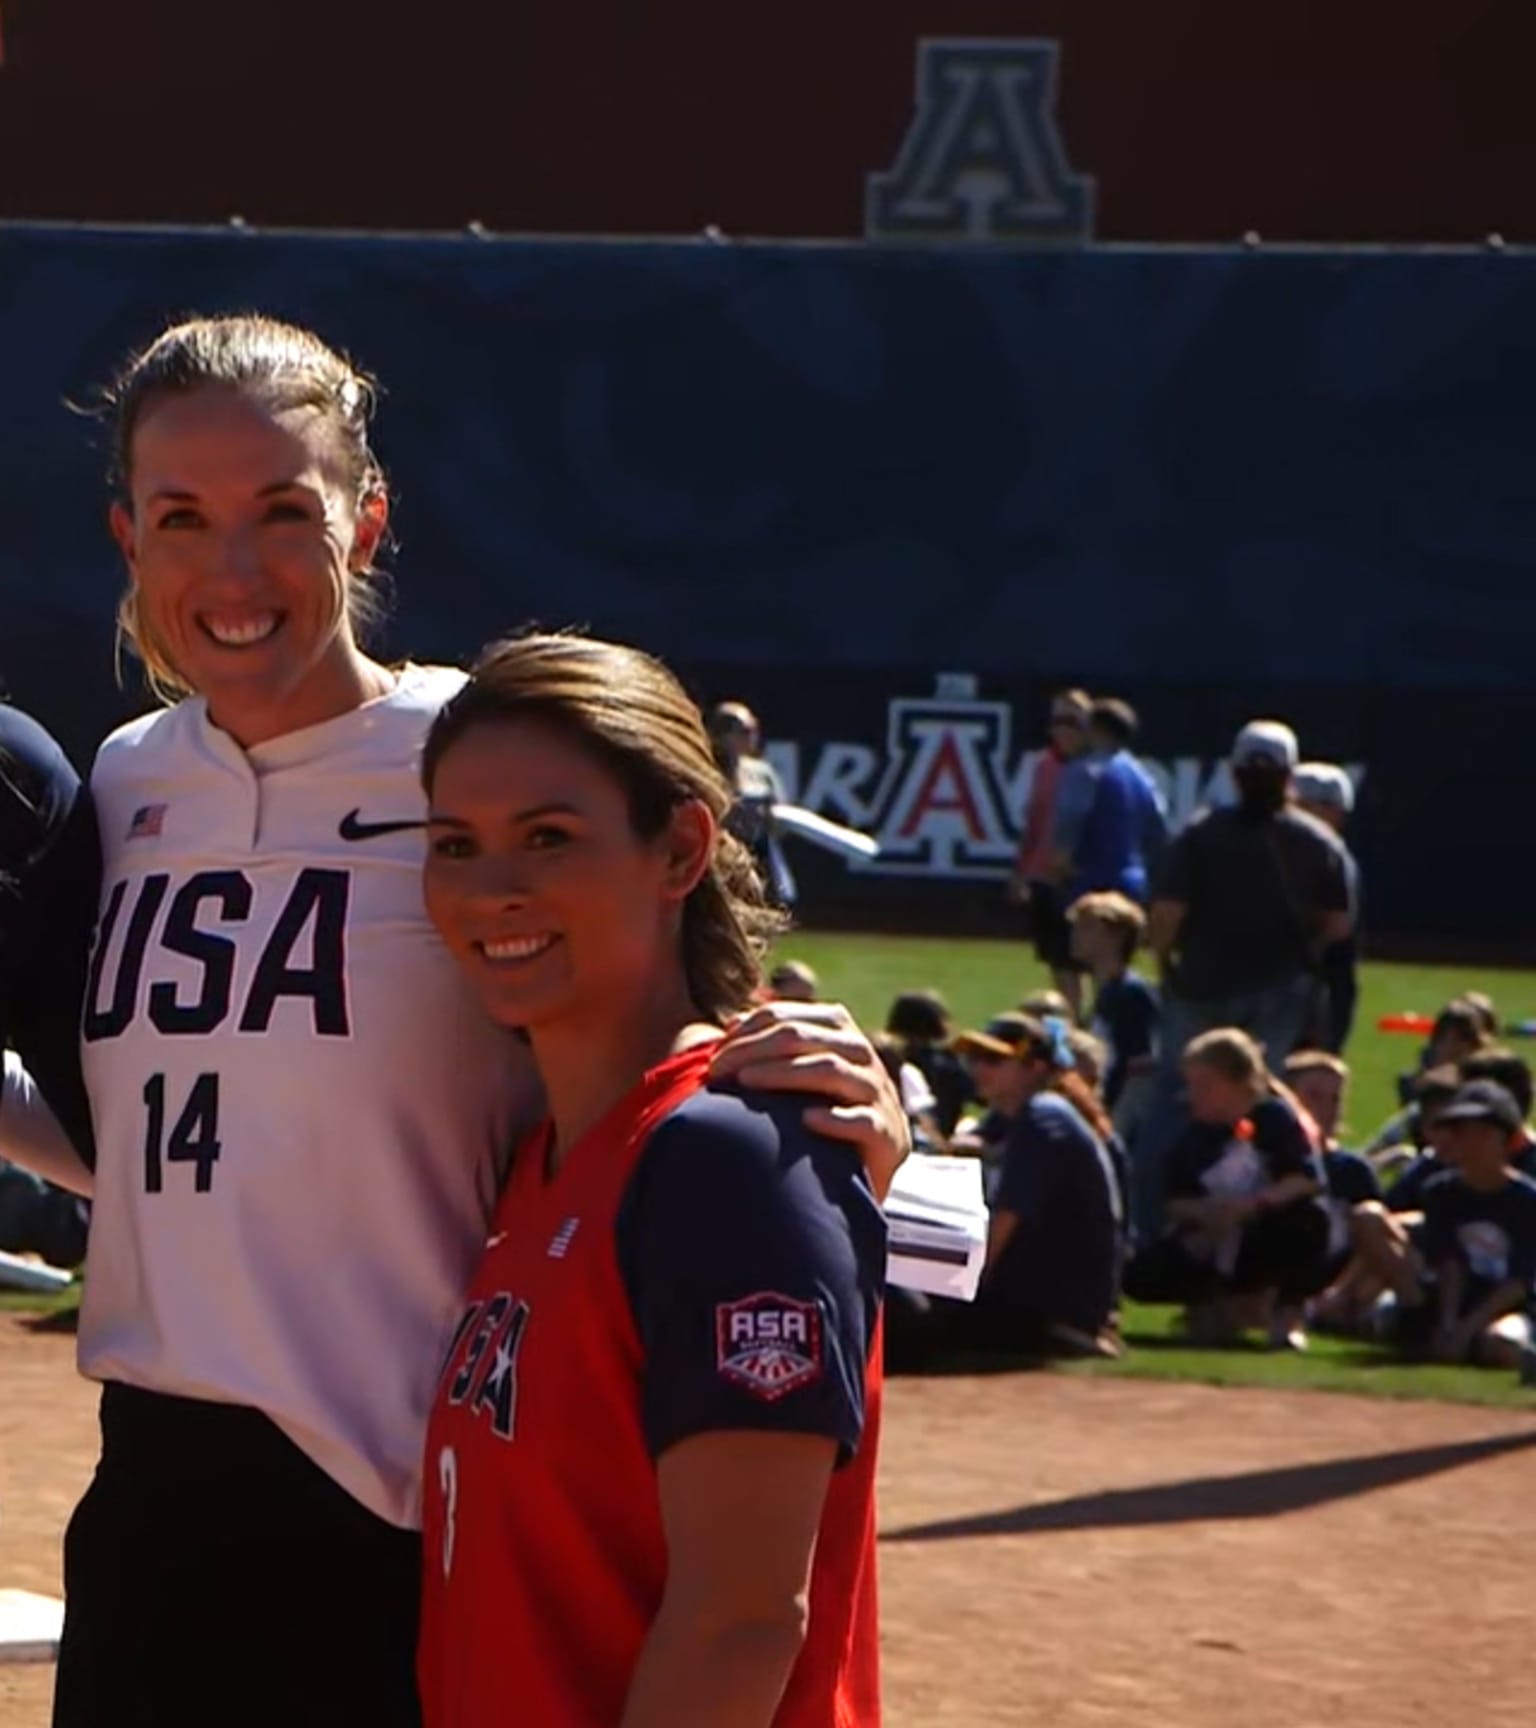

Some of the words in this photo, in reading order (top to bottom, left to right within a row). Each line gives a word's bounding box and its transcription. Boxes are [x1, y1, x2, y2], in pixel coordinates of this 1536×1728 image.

[865, 37, 1097, 246] A
[848, 697, 1020, 877] A
[82, 866, 352, 1044] USA
[142, 1072, 222, 1194] 14
[730, 1310, 807, 1343] ASA
